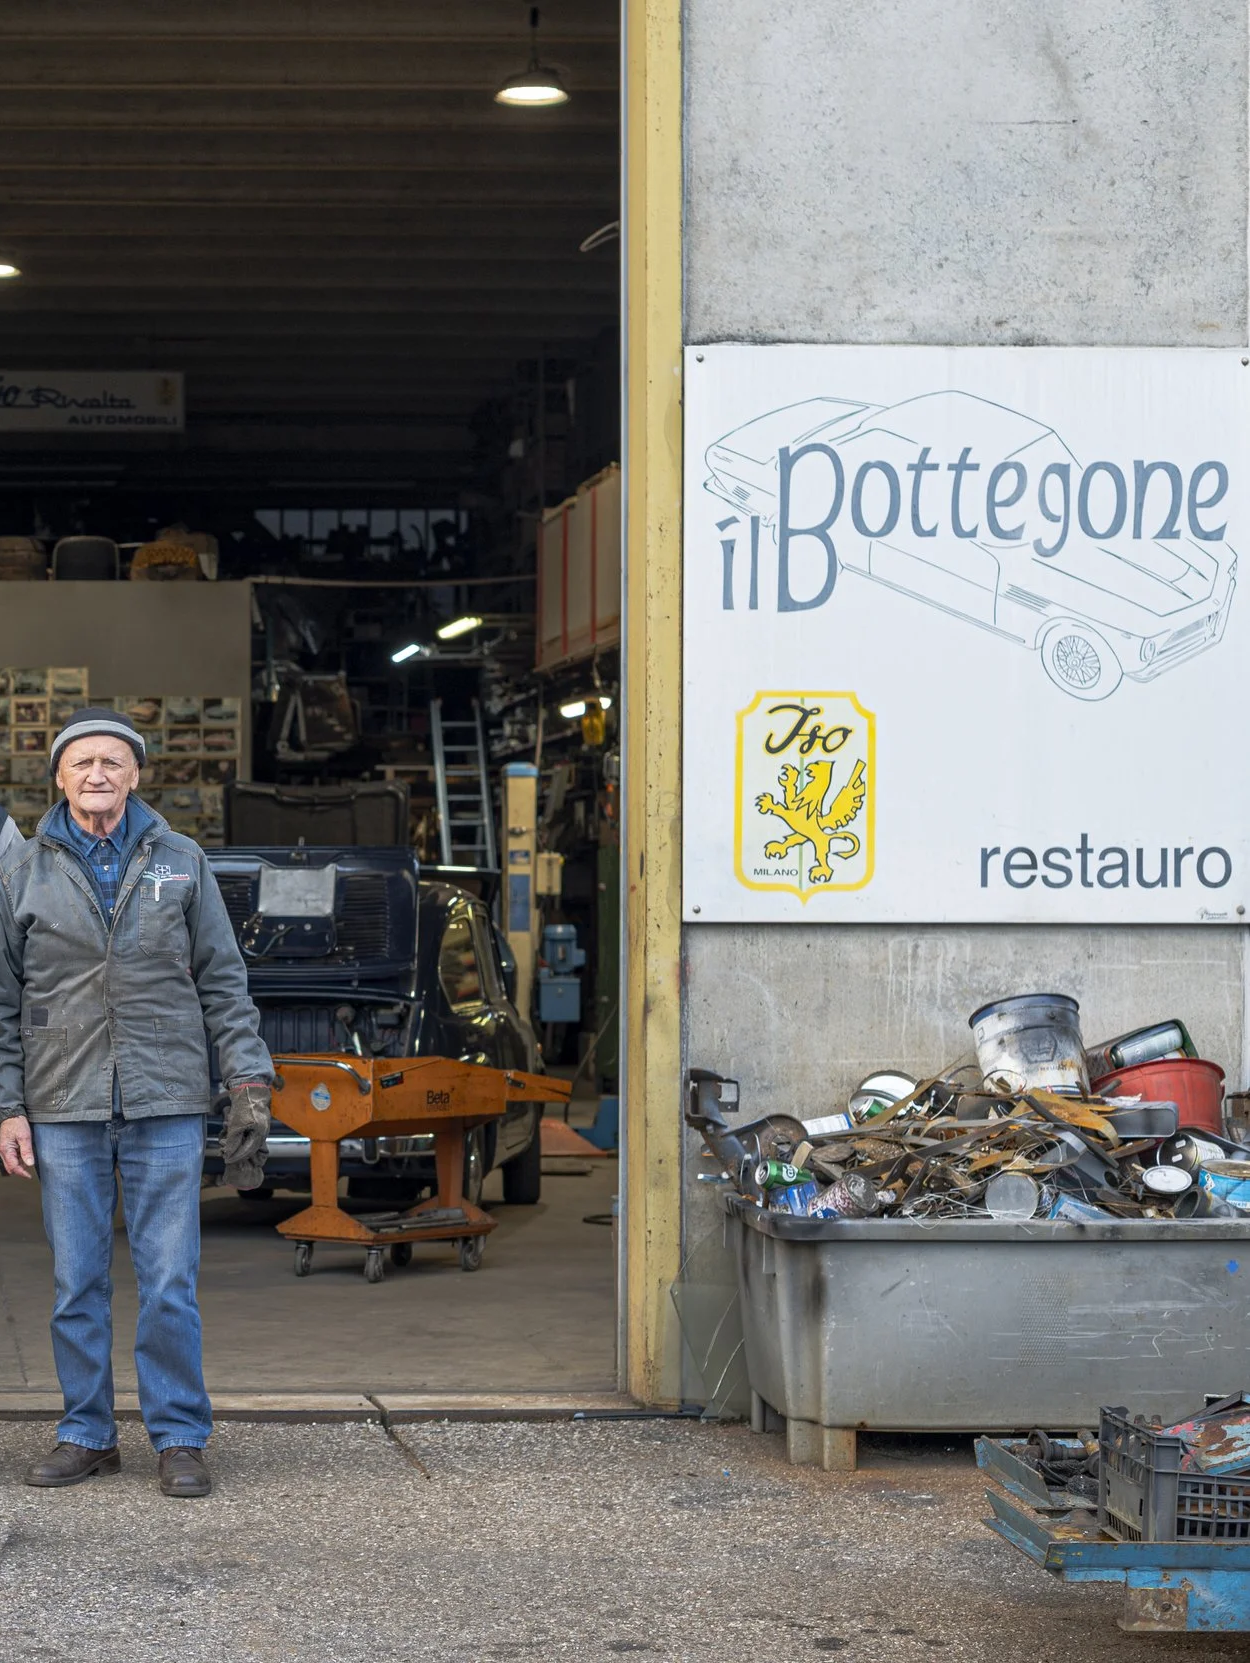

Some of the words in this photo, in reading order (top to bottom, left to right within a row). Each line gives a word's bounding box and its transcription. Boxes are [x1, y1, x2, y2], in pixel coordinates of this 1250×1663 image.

[68, 415, 178, 425] AUTOMOBILI
[777, 443, 1230, 614] Bottegone
[764, 703, 854, 755] Iso
[753, 868, 799, 876] MILANO
[980, 832, 1232, 889] restauro
[427, 1089, 450, 1104] Beta
